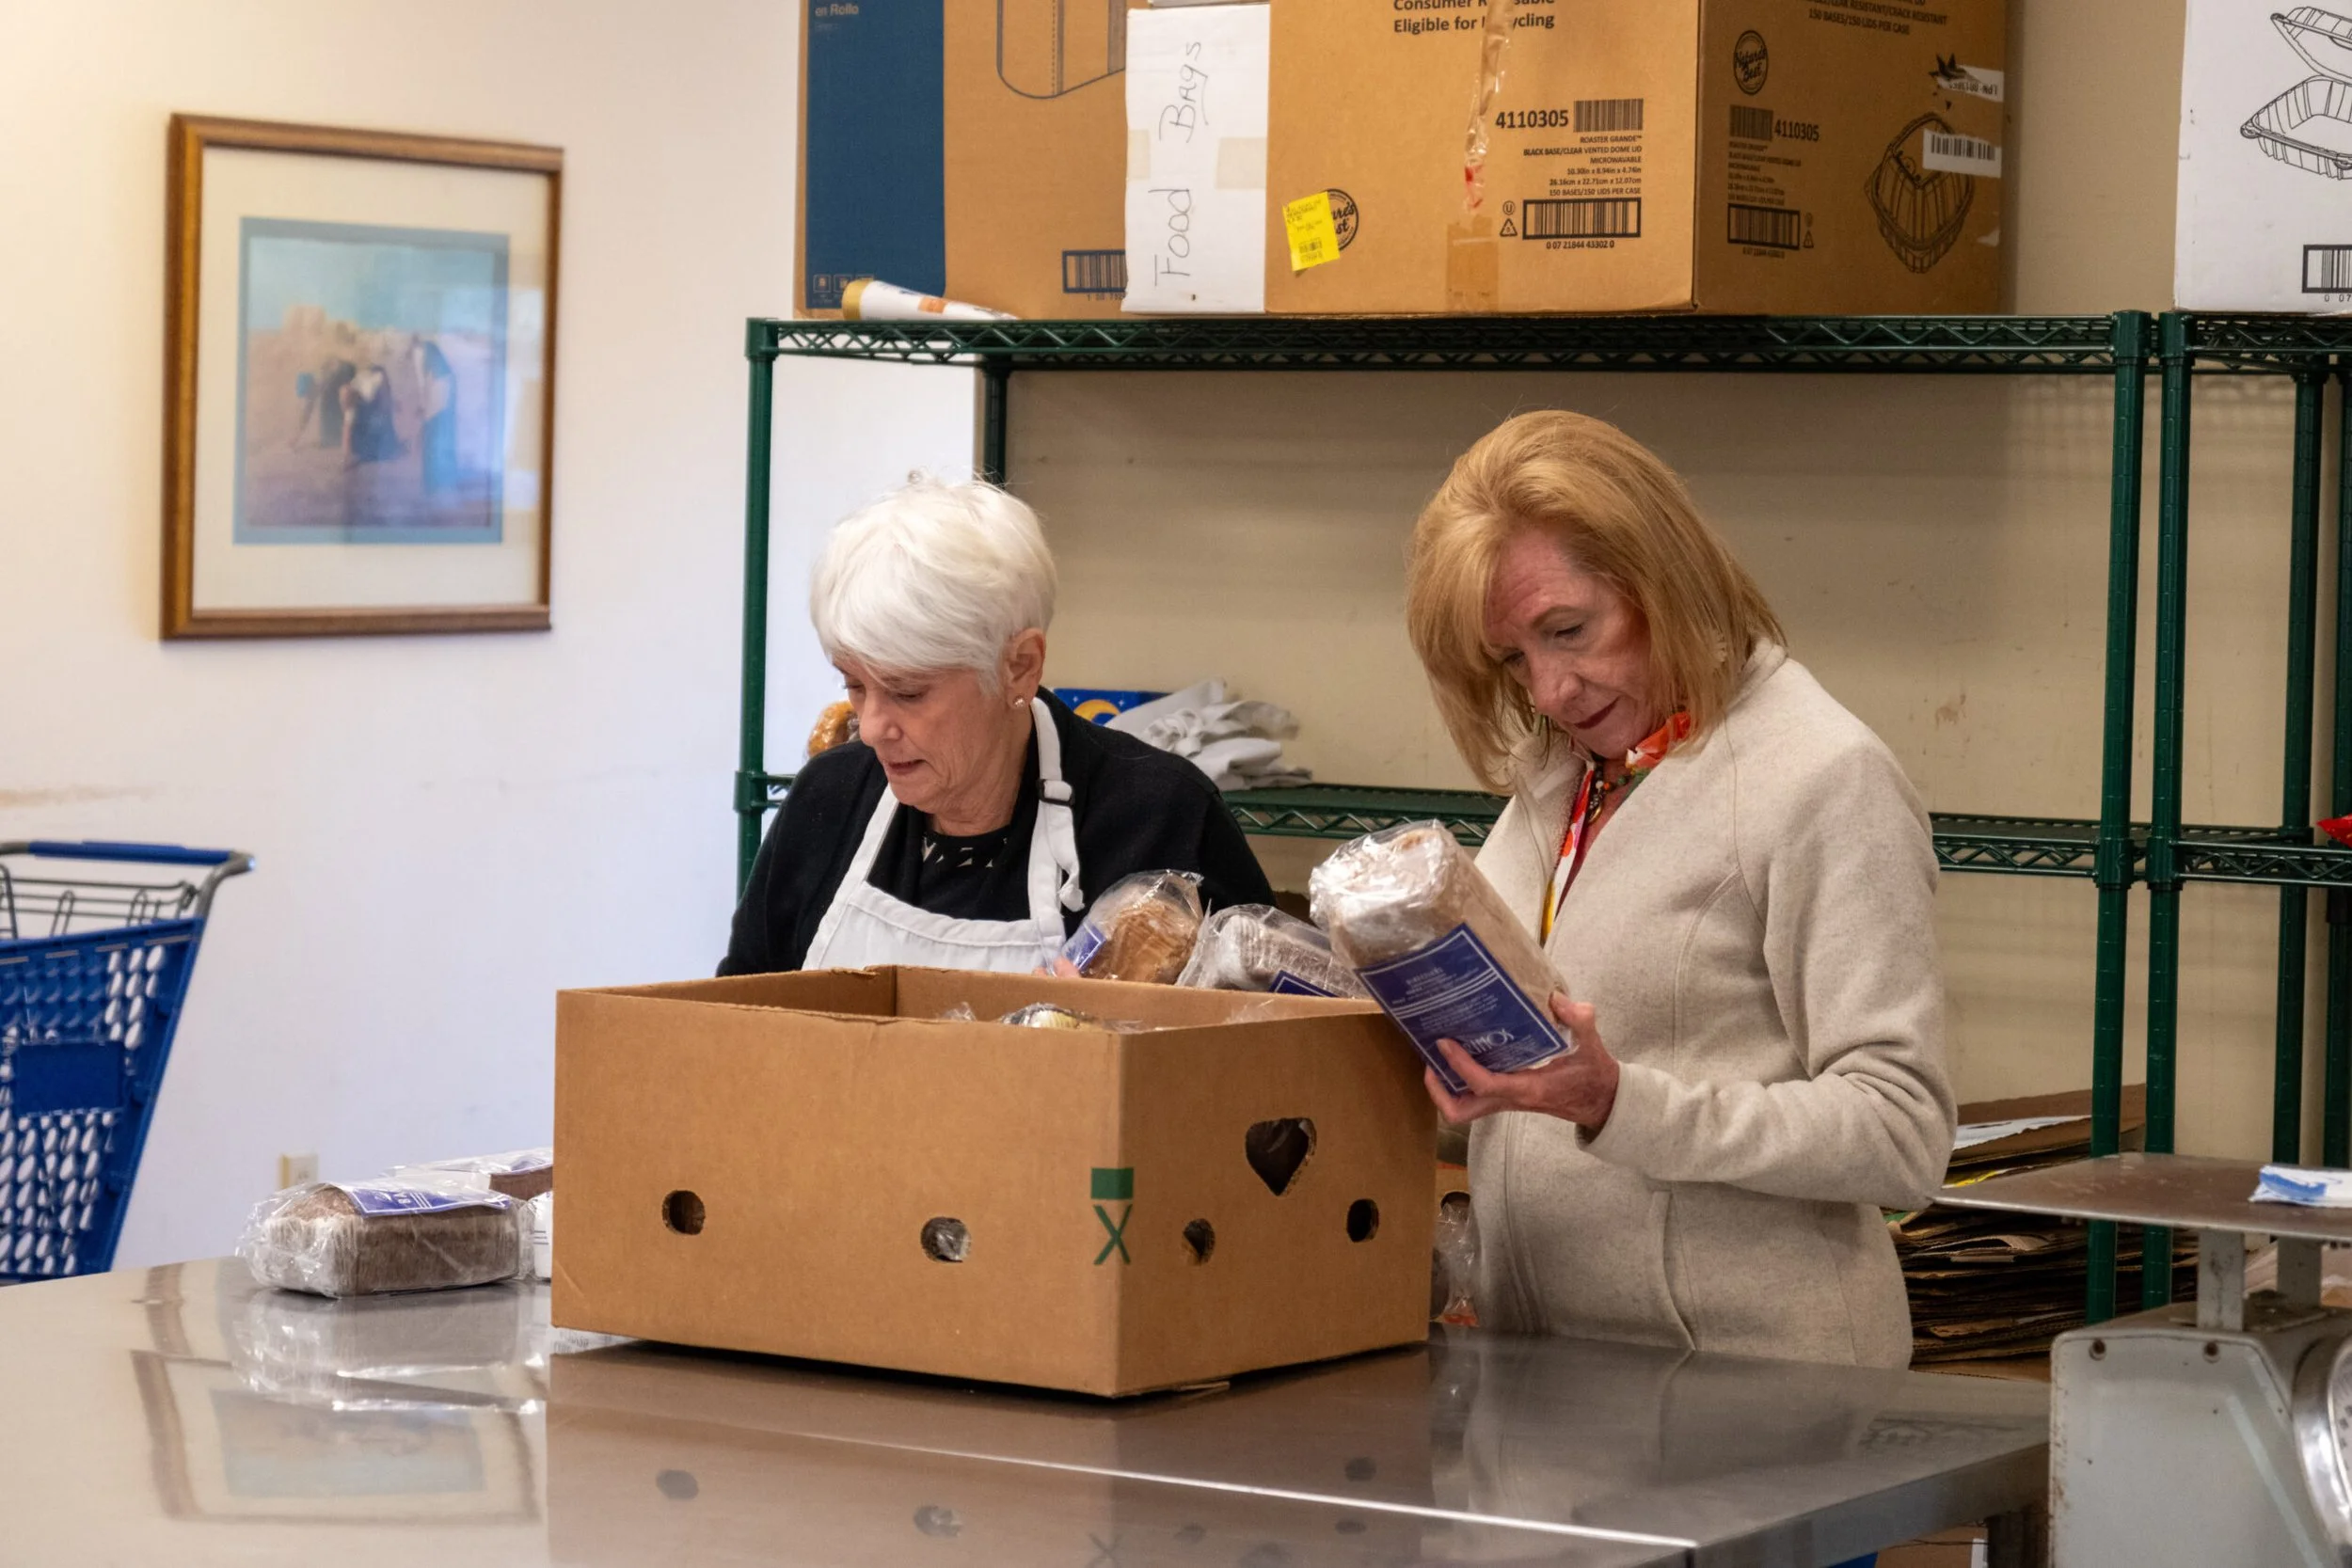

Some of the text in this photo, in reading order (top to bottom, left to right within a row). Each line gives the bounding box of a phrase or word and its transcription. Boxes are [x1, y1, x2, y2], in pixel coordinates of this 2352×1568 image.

[1393, 0, 1471, 10] Consumer
[1394, 18, 1450, 35] Eligible
[1454, 16, 1477, 30] for
[1495, 109, 1569, 129] 4110305
[1774, 119, 1820, 142] 4110305
[1523, 148, 1543, 156] BLACK
[1545, 146, 1582, 155] BASE/CLEAR
[1584, 146, 1609, 154] VENTED
[1610, 145, 1629, 153] DOME
[1549, 188, 1561, 197] 150
[1562, 188, 1596, 197] BASES/150
[1625, 186, 1641, 195] CASE
[1148, 188, 1192, 287] Food
[1563, 241, 1584, 249] 21844
[2324, 293, 2330, 302] 0
